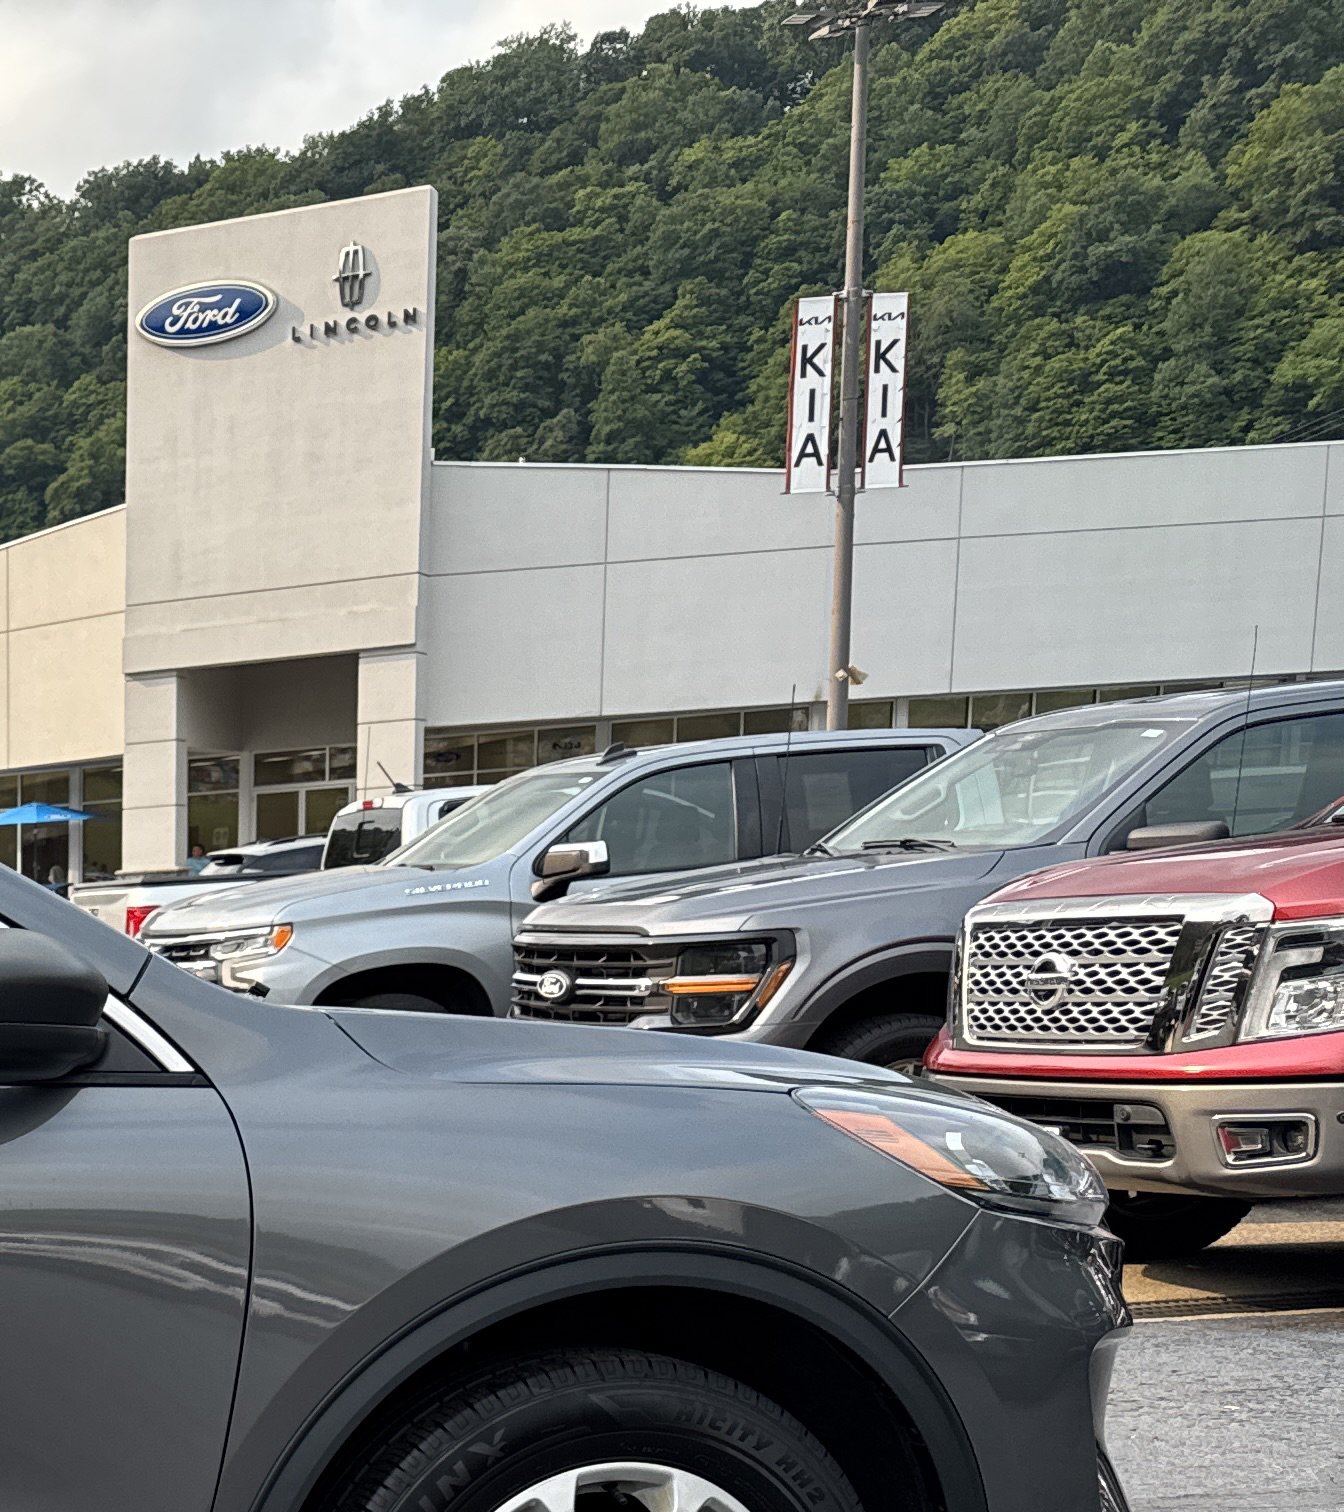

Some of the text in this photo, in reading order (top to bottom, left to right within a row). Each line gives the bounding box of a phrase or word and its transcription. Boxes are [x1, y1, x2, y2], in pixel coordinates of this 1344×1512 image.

[164, 293, 242, 333] Ford
[292, 307, 418, 343] LINCOLN
[794, 342, 827, 468] KIA
[868, 338, 901, 463] KIA
[775, 1453, 826, 1506] HH2
